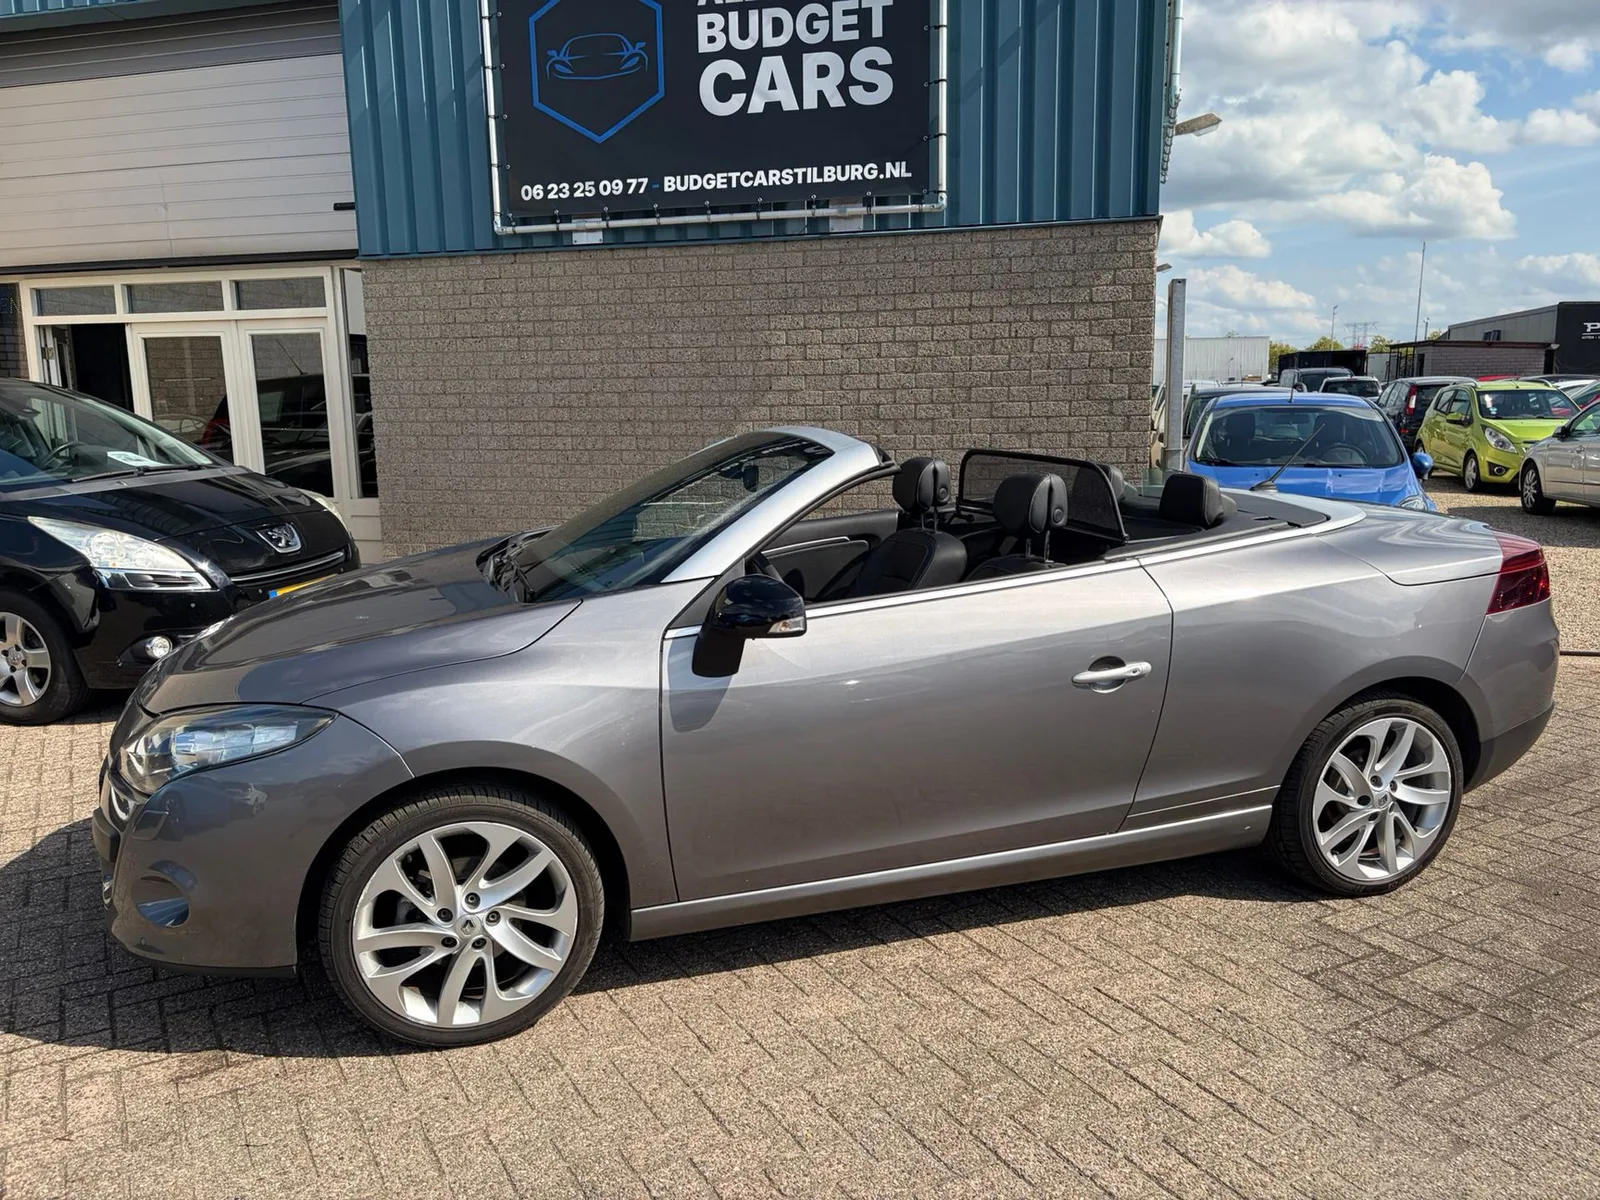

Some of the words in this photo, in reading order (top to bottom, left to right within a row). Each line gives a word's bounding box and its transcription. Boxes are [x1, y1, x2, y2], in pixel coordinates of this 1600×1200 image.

[697, 0, 894, 53] BUDGET
[699, 46, 894, 116] CARS
[520, 185, 544, 201] 06
[547, 183, 570, 199] 23
[573, 181, 596, 198] 25
[599, 179, 623, 196] 09
[626, 178, 649, 194] 77
[663, 161, 912, 192] BUDGETCARSTILBURG.NL
